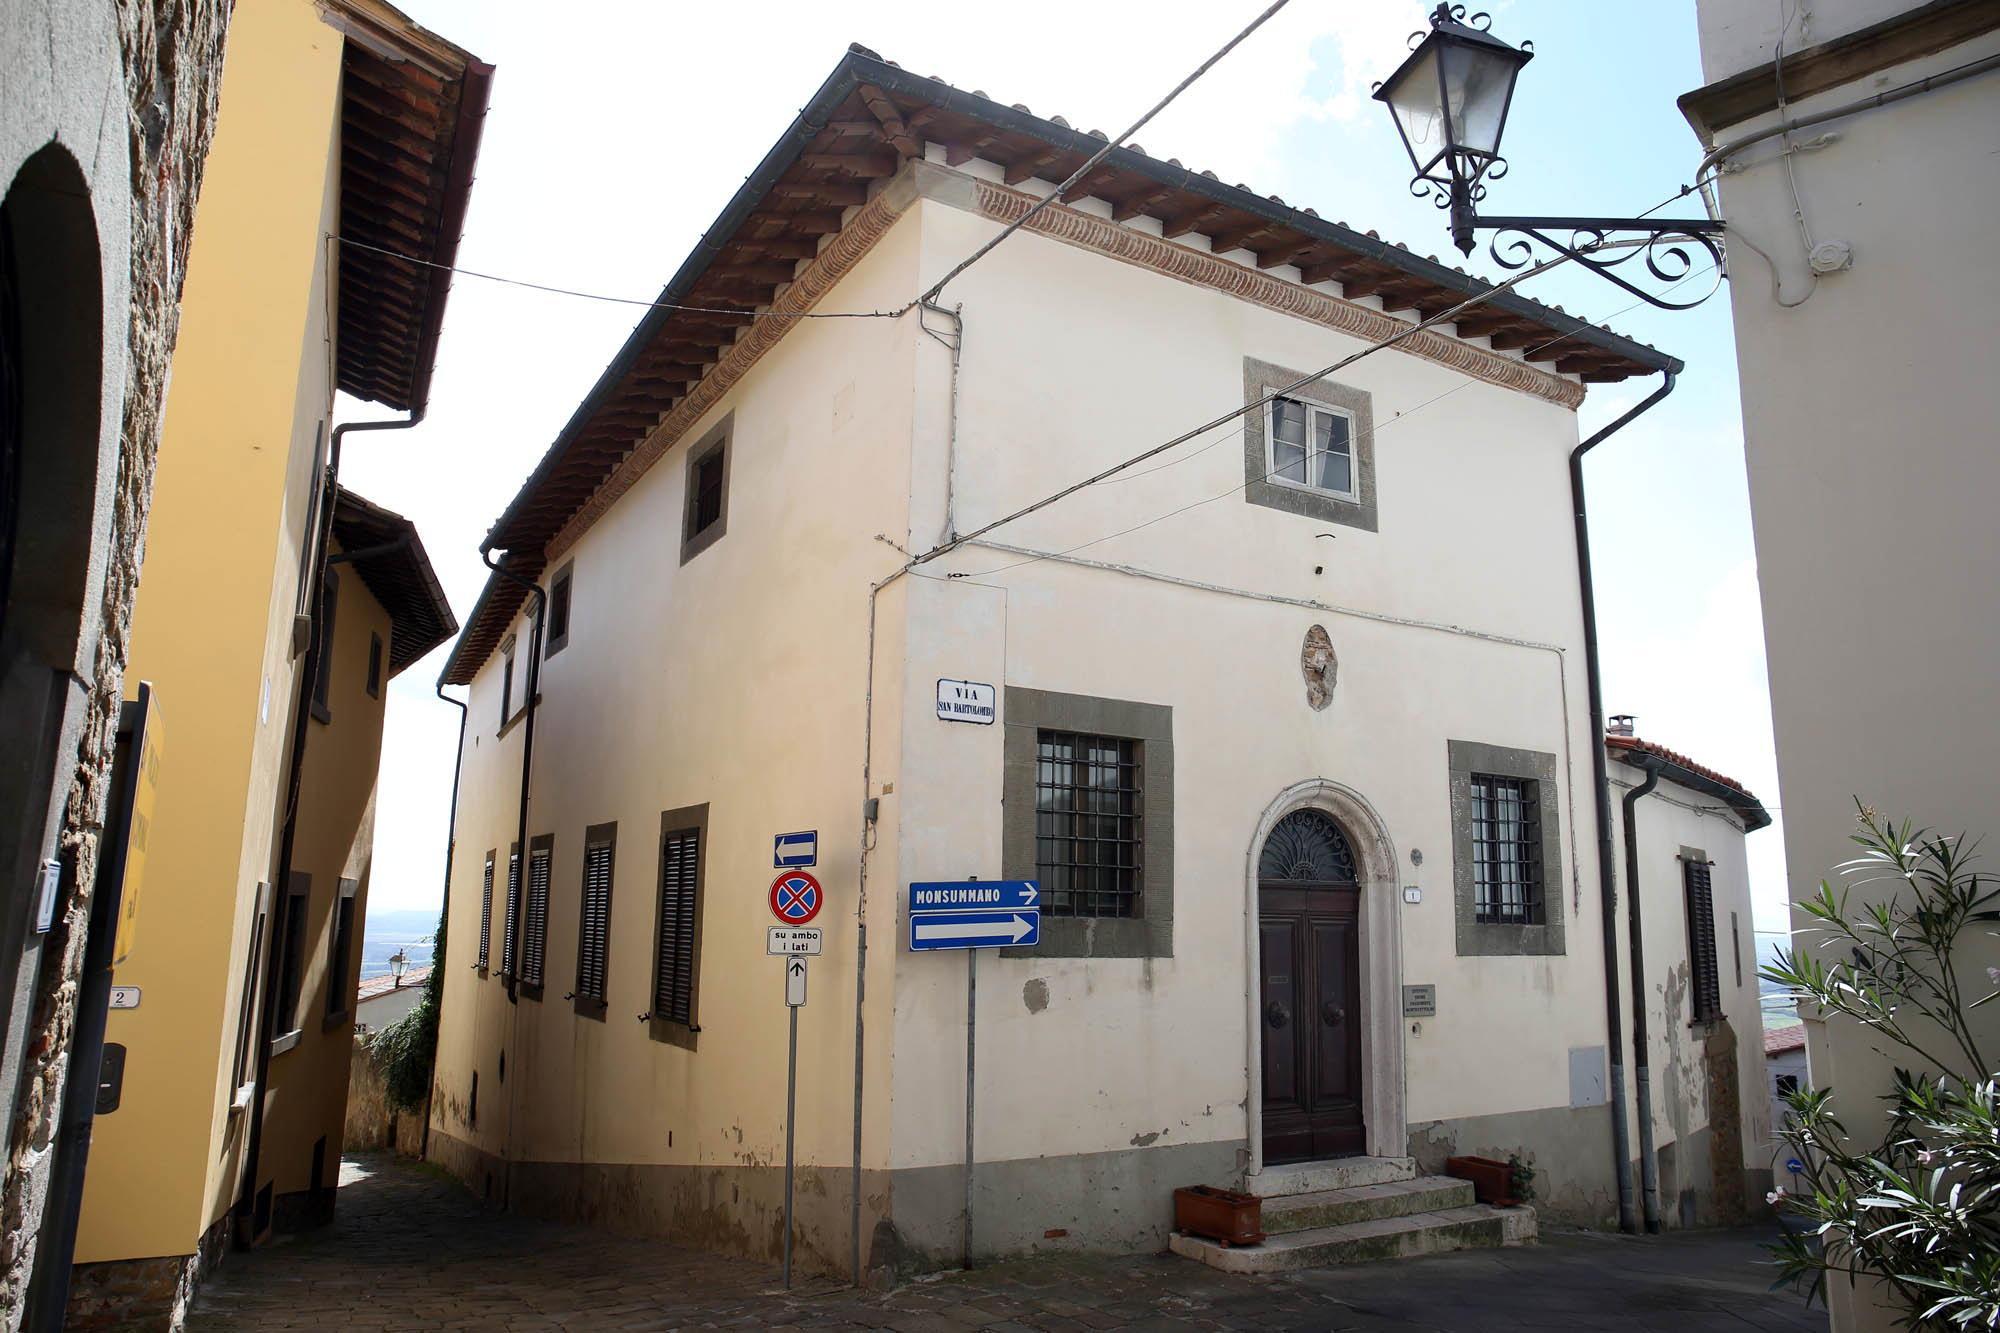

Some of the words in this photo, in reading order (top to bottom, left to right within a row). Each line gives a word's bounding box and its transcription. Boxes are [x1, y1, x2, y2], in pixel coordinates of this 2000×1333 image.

[955, 687, 978, 701] VIA
[938, 701, 952, 712] SAN
[916, 888, 1001, 904] MONSUMMANO
[791, 931, 818, 940] ambo
[791, 942, 809, 951] lati
[115, 991, 125, 1004] 2
